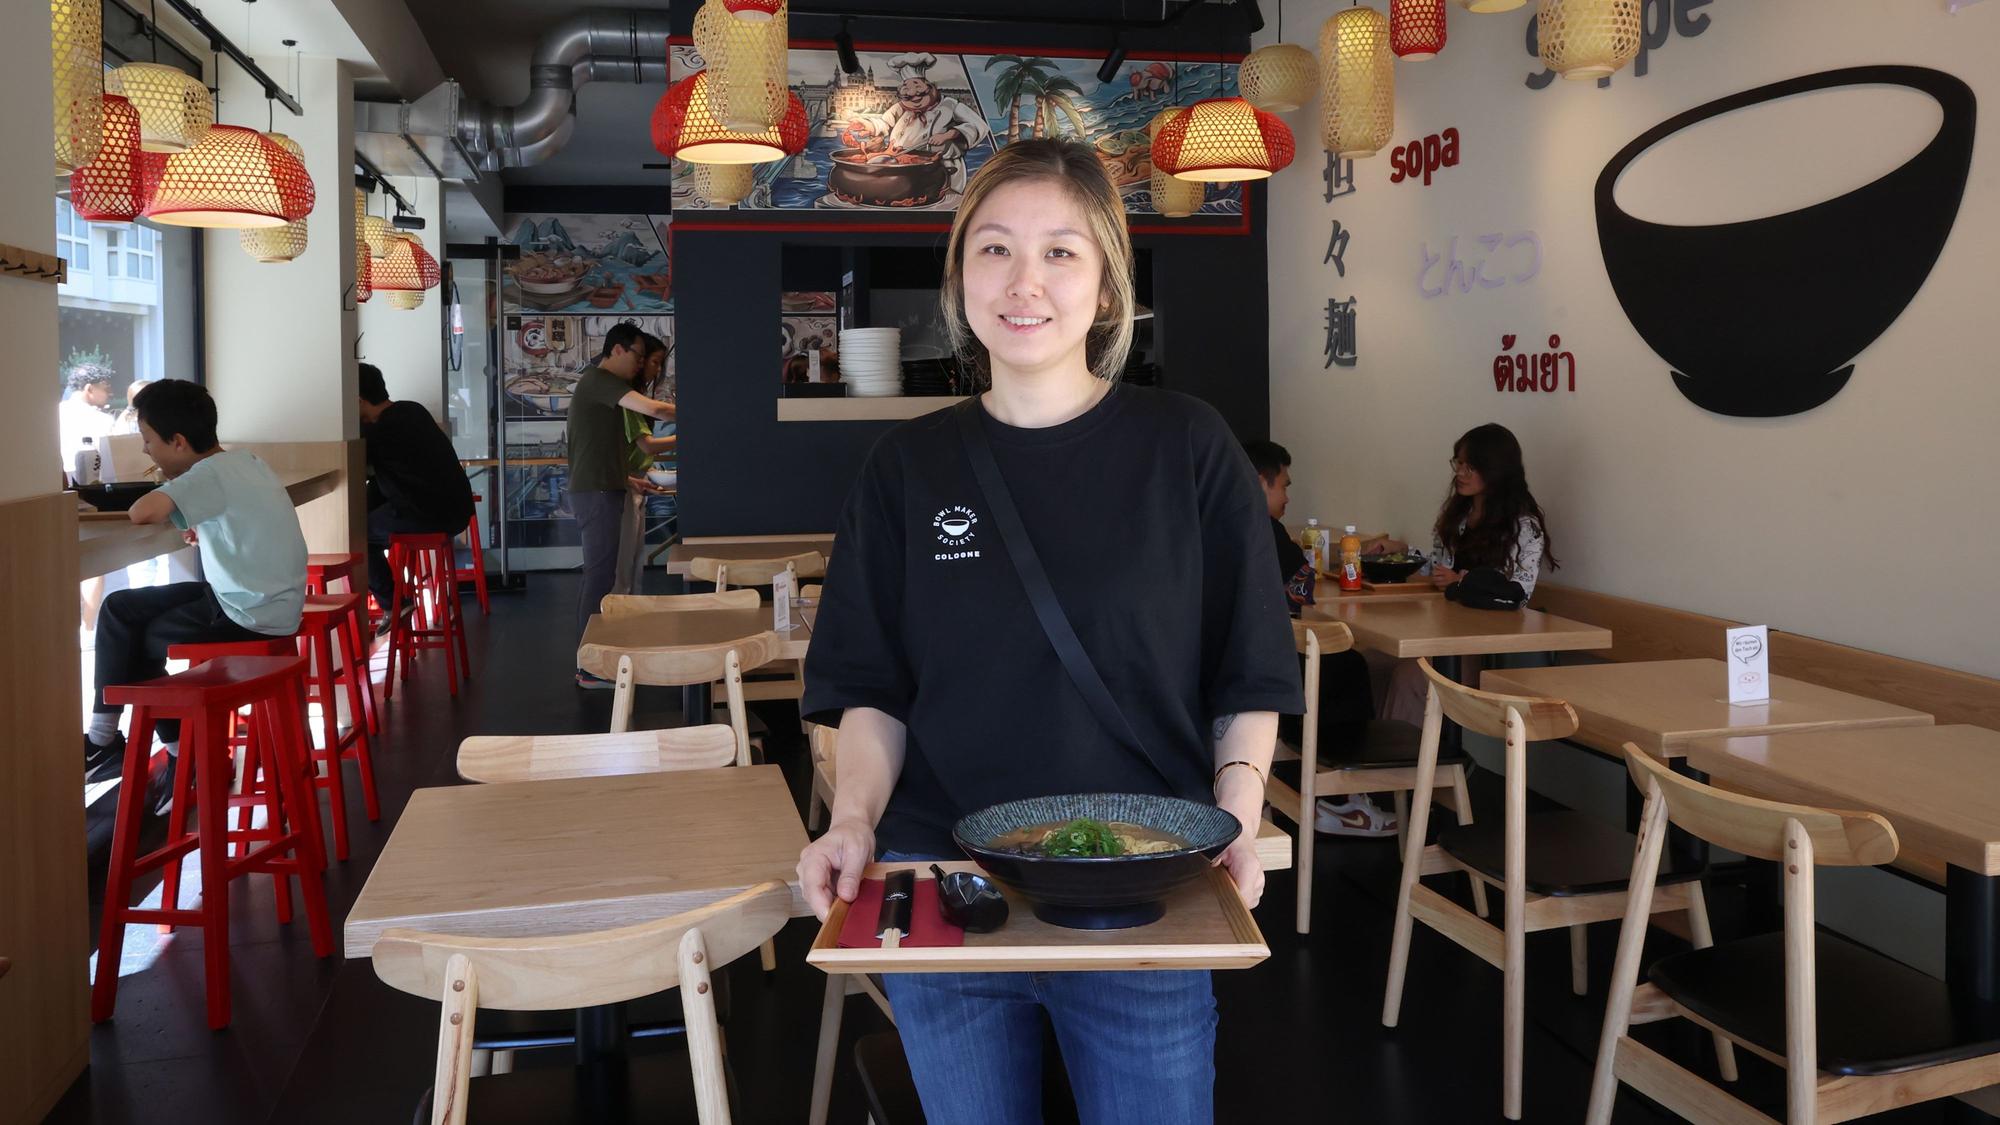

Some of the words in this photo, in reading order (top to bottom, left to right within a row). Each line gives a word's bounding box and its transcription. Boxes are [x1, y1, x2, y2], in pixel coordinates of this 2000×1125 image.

[1390, 127, 1460, 186] sopa
[1416, 229, 1544, 299] とんこつ
[1493, 334, 1576, 392] ต้มยำ
[933, 508, 951, 527] BOWL
[954, 506, 978, 524] MAKER
[935, 551, 980, 560] COLOGNE
[937, 532, 975, 546] SOCIETY
